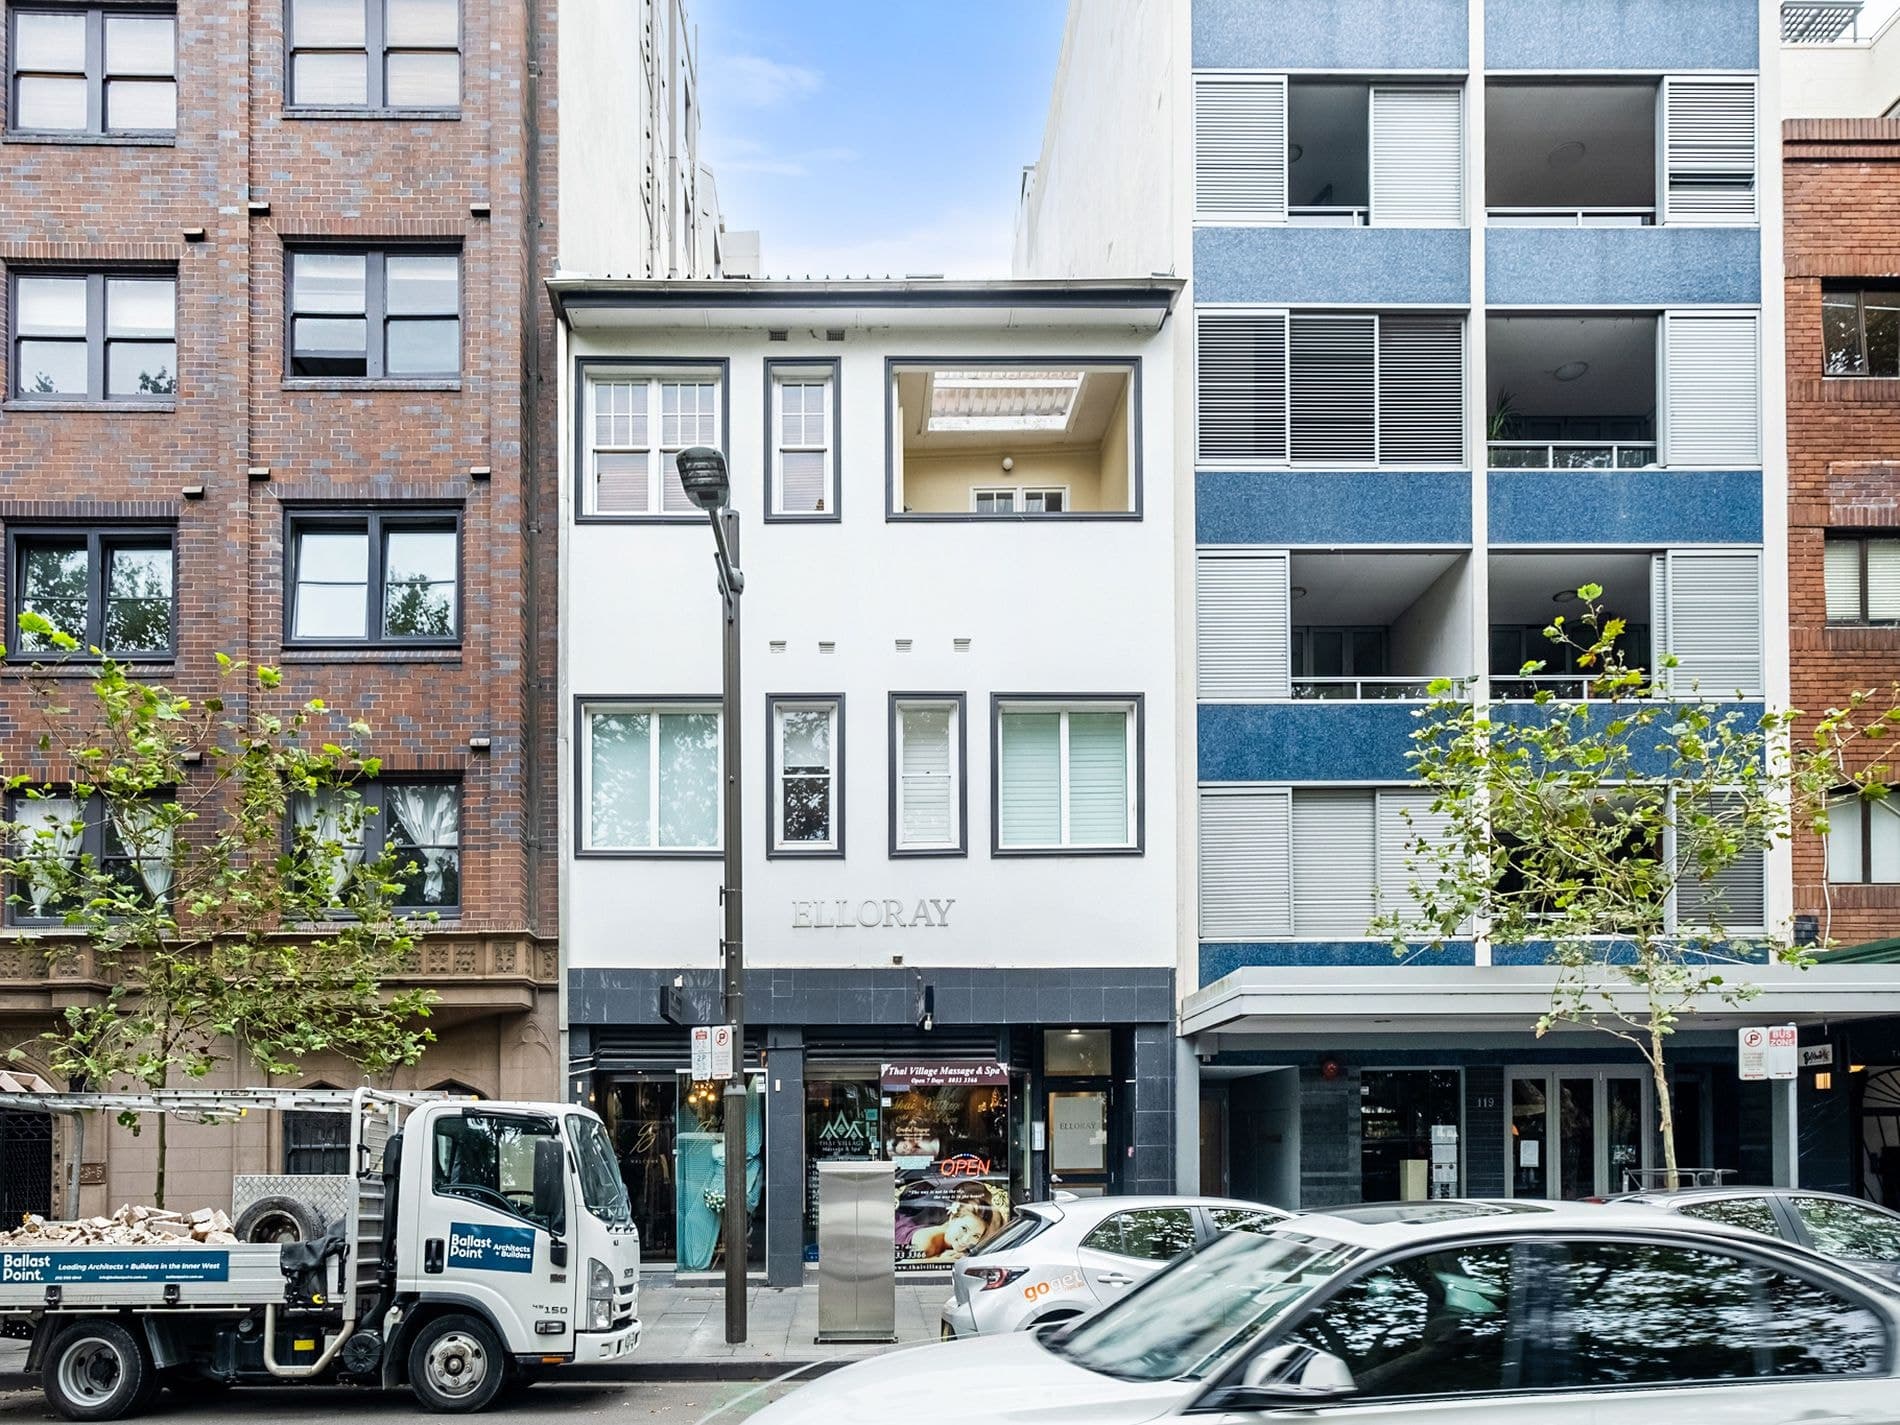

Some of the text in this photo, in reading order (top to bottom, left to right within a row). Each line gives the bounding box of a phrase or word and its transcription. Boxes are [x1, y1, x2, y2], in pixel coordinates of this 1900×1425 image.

[791, 899, 956, 928] ELLORAY
[1772, 1030, 1792, 1039] BUS
[1769, 1039, 1793, 1047] ZONE
[888, 1066, 1001, 1078] Thai Village Massage & Spa
[1477, 1098, 1495, 1108] 119
[1060, 1122, 1096, 1130] ELLORAY
[941, 1159, 991, 1176] OPEN
[451, 1234, 492, 1248] Ballast
[450, 1245, 483, 1259] Point
[493, 1244, 531, 1253] Architects
[3, 1253, 51, 1267] Ballast
[501, 1250, 532, 1259] Builders
[58, 1263, 87, 1272] Leading
[88, 1262, 124, 1271] Architects
[130, 1262, 159, 1270] Builders
[160, 1262, 167, 1270] in
[169, 1262, 180, 1270] the
[182, 1262, 200, 1270] Inner
[3, 1268, 44, 1281] Point.
[1024, 1269, 1081, 1302] goget
[544, 1306, 568, 1314] 150
